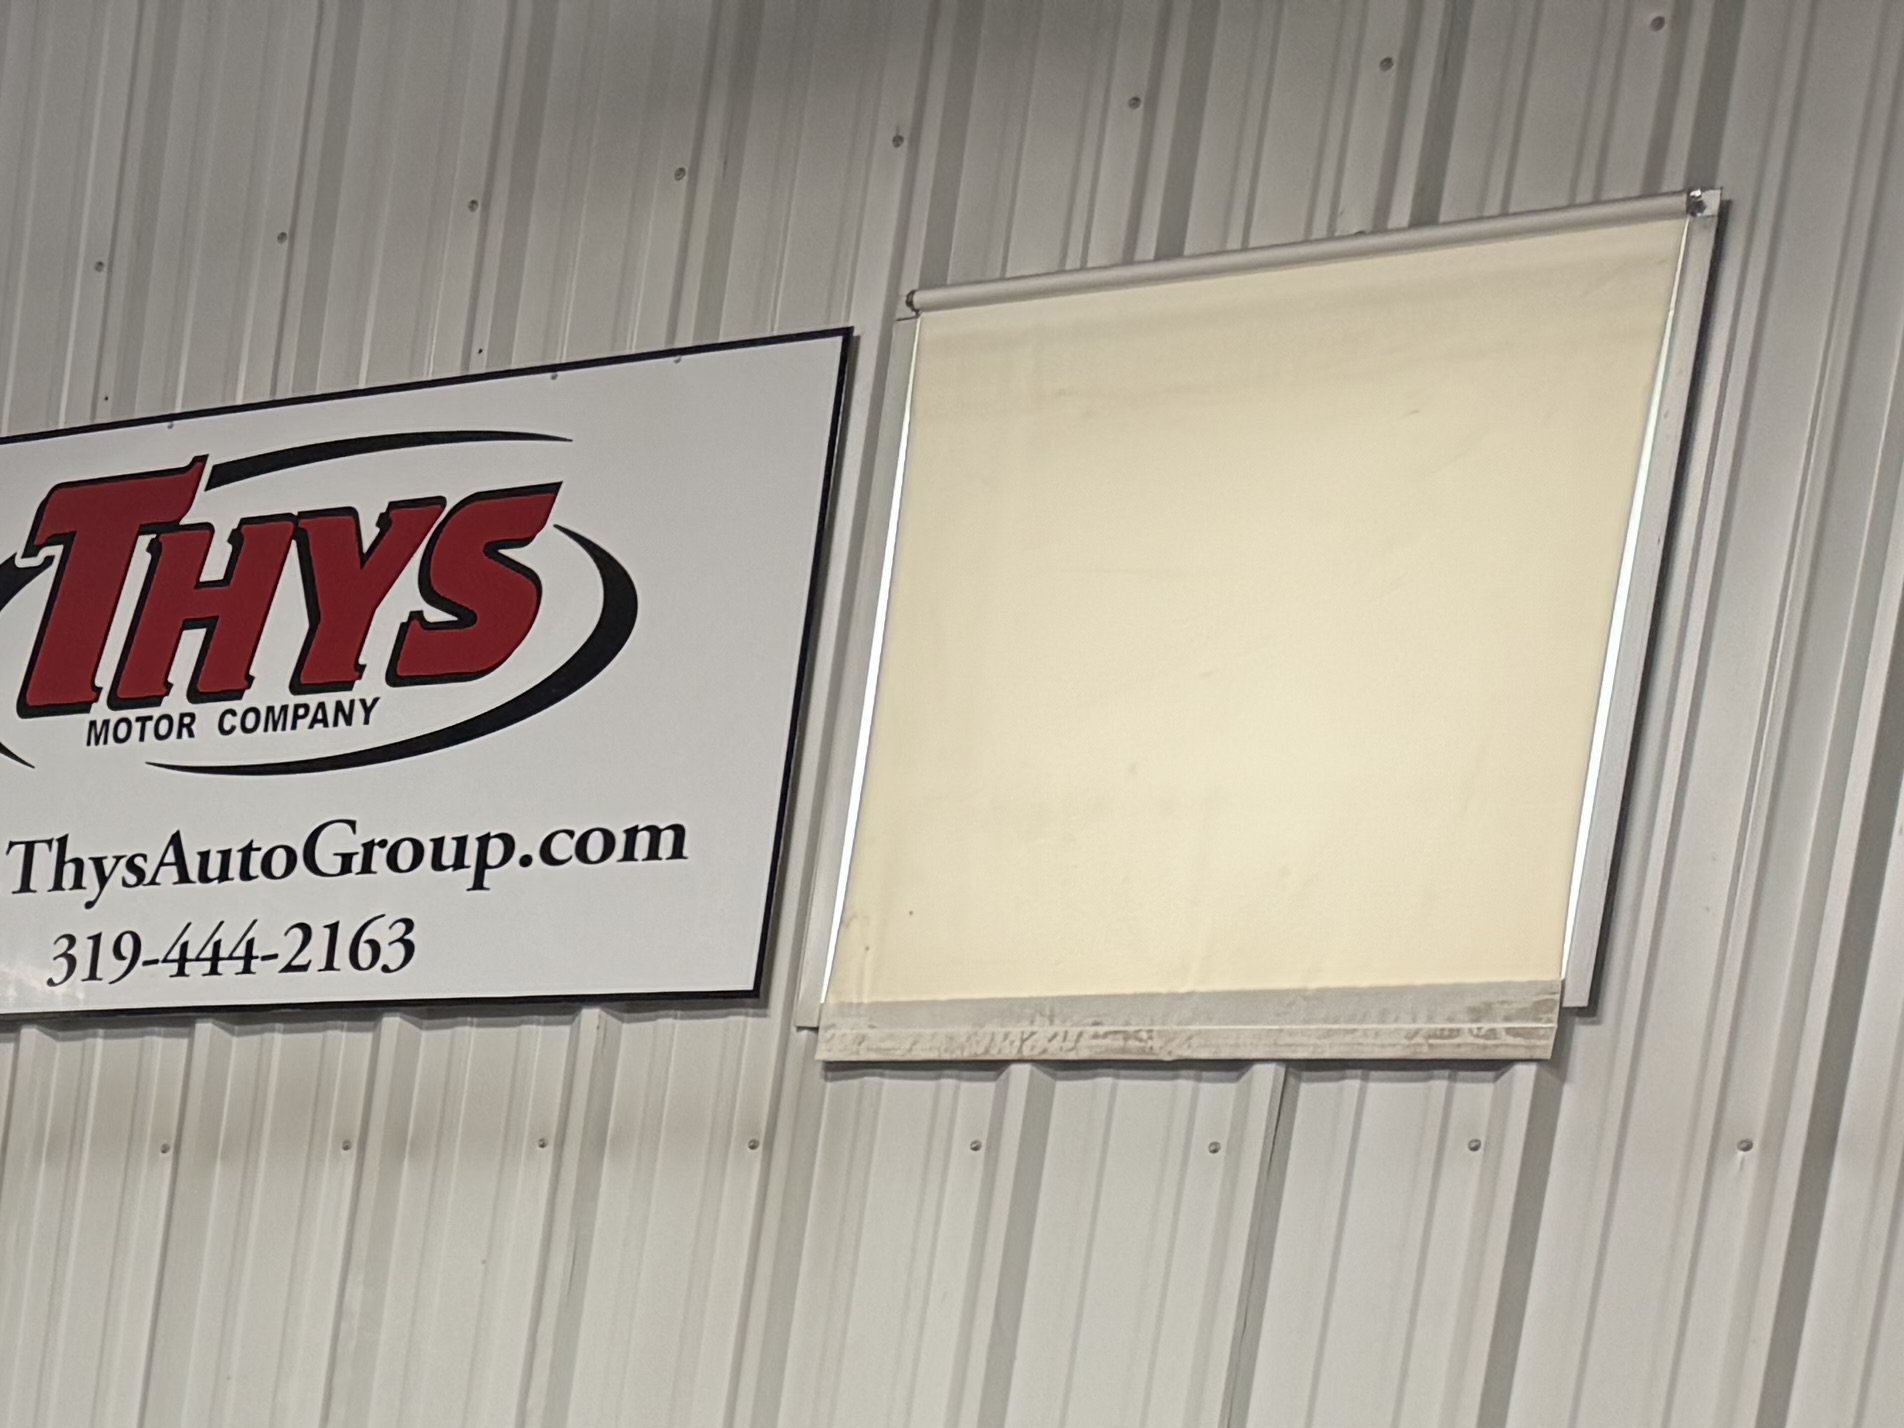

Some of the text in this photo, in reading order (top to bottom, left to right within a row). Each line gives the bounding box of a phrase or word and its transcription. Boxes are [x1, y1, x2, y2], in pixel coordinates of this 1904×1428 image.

[85, 696, 382, 748] MOTOR COMPANY
[45, 916, 418, 989] 319-444-2163
